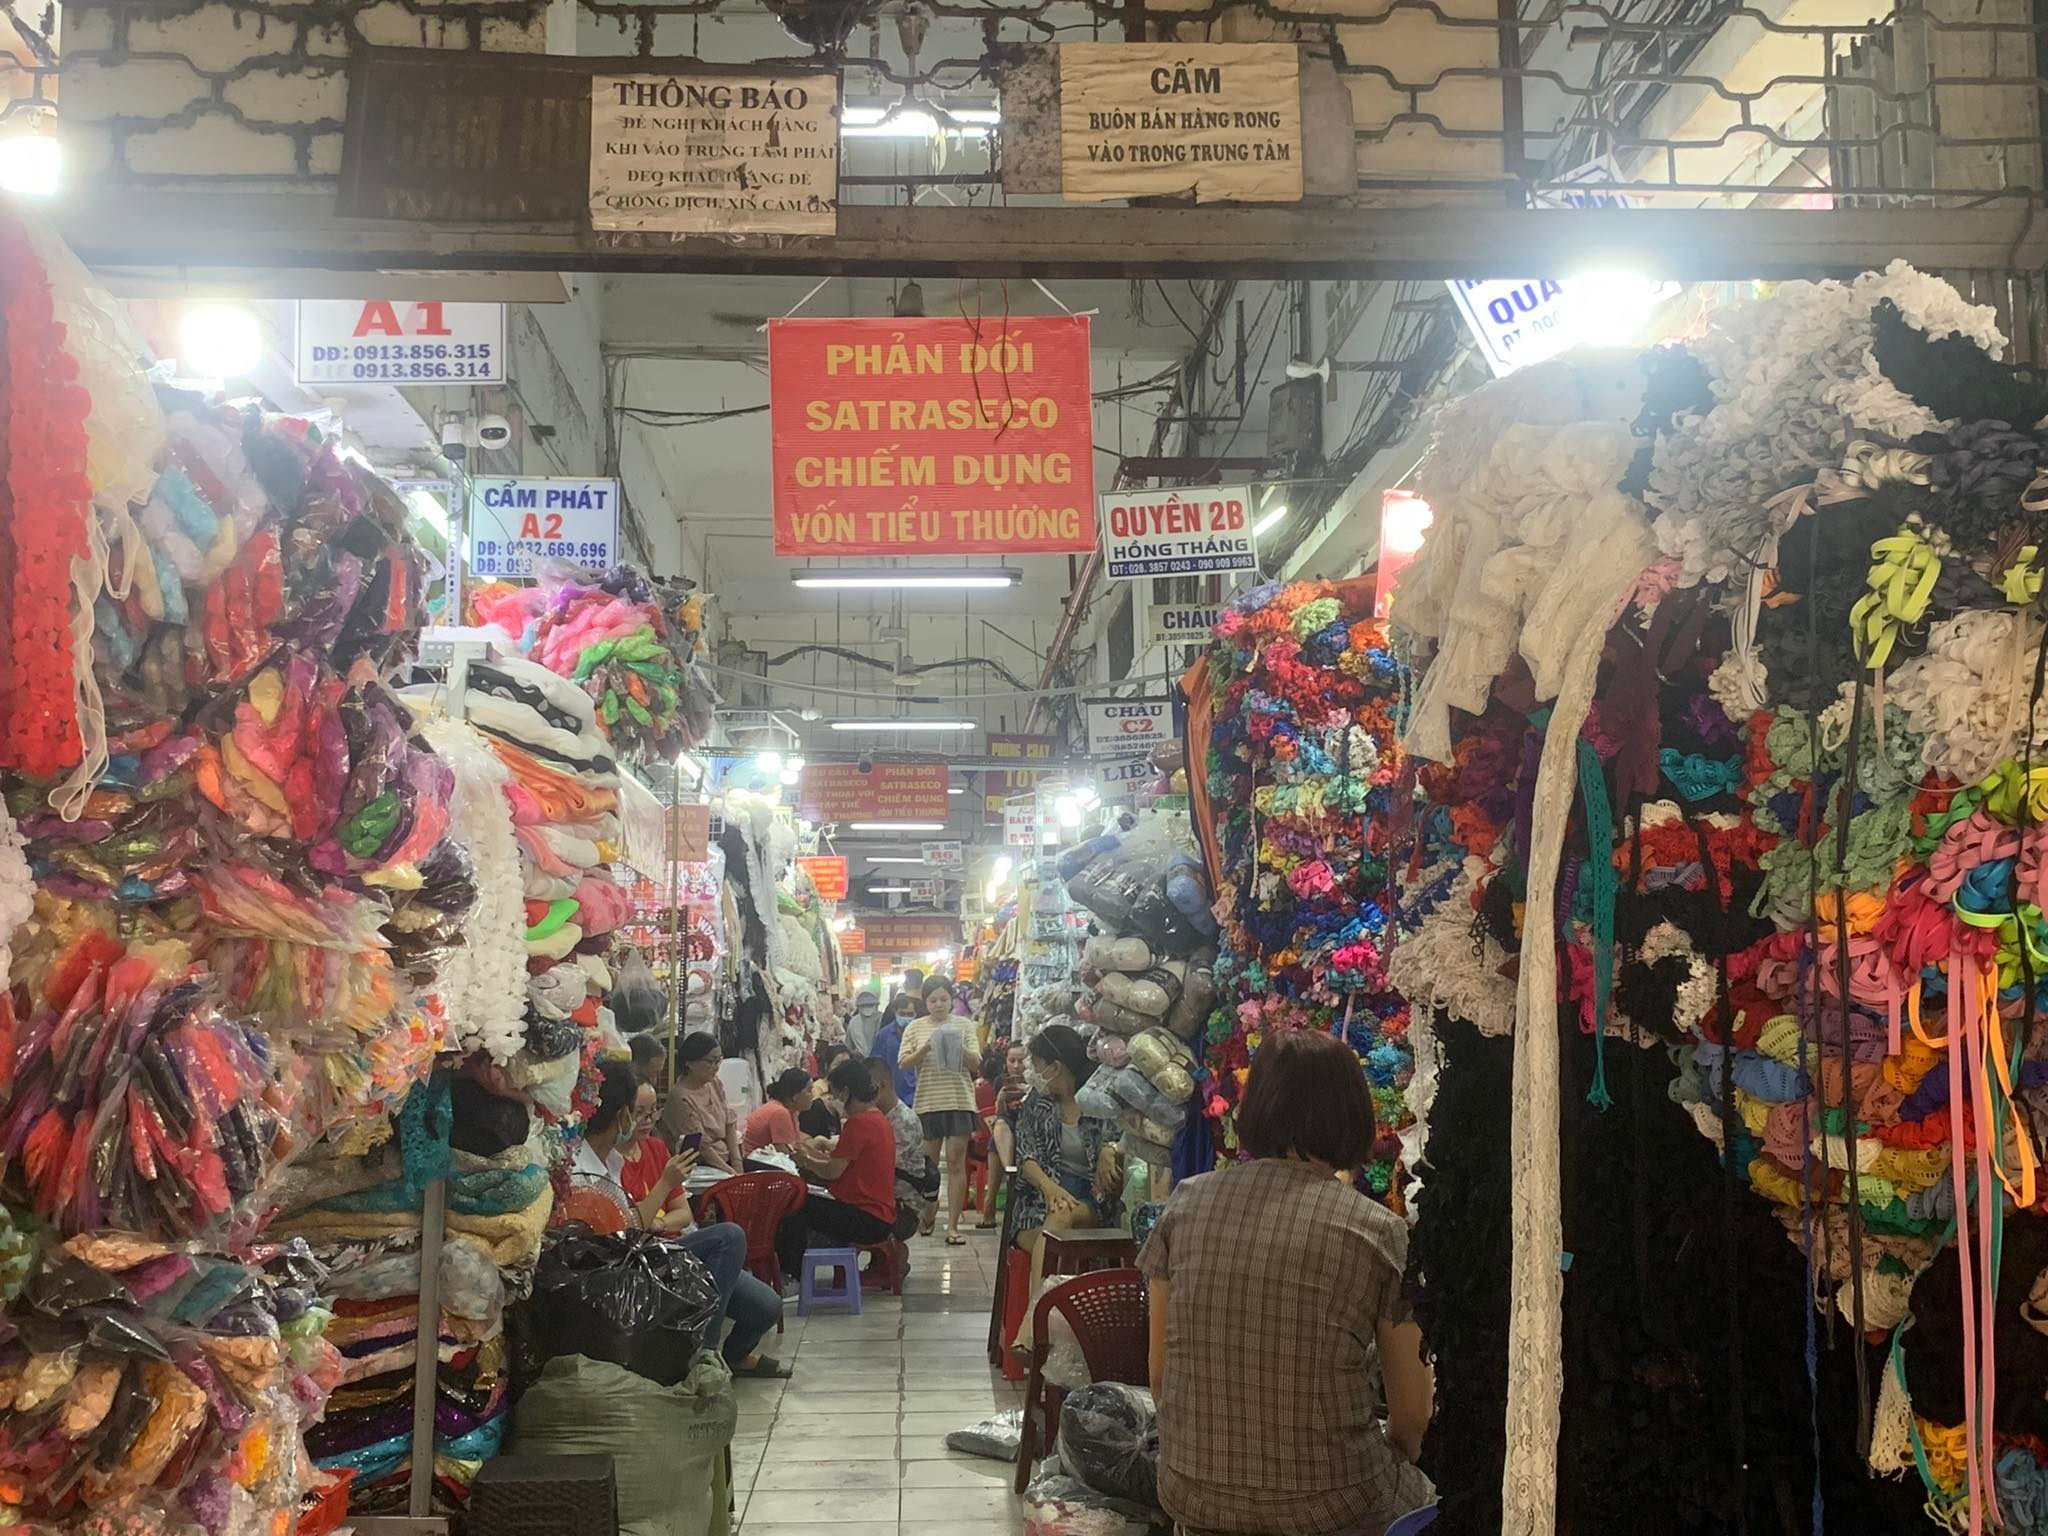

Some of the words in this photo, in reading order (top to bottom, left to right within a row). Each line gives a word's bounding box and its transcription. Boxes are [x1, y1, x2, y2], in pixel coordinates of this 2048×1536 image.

[1150, 58, 1221, 94] CẤM
[613, 78, 732, 109] THÔNG
[741, 80, 809, 110] BÁO
[652, 117, 695, 133] NGHỊ
[701, 115, 762, 133] KHÁCH
[1089, 107, 1136, 130] BUÔN
[1141, 107, 1176, 129] BÁN
[1181, 107, 1229, 129] HÀNG
[1233, 111, 1281, 129] RONG
[606, 142, 637, 155] KHI
[643, 140, 680, 156] VÀO
[685, 144, 745, 157] TRUNG
[1088, 140, 1125, 162] VÀO
[1129, 144, 1186, 162] TRONG
[1191, 144, 1249, 162] TRUNG
[1253, 138, 1291, 161] TÂM
[352, 299, 452, 337] A1
[353, 344, 491, 361] 0913.856.315
[826, 332, 944, 375] PHẢN
[959, 330, 1034, 374] ĐỐI
[353, 362, 491, 378] 0913.856.314
[806, 398, 1058, 431] SATRASECO
[795, 444, 936, 487] CHIẾM
[953, 453, 1072, 491] DỤNG
[484, 480, 537, 508] CẨM
[545, 484, 608, 510] PHÁT
[520, 513, 564, 539] A2
[790, 500, 856, 543] VỐN
[867, 496, 940, 542] TIỂU
[952, 503, 1080, 540] THƯƠNG
[1110, 493, 1202, 538] QUYỀN
[1208, 500, 1245, 532] 2B
[477, 541, 501, 556] DĐ:
[1114, 540, 1172, 560] HỒNG
[1177, 534, 1249, 555] THẮNG
[477, 558, 501, 573] DĐ:
[1163, 605, 1218, 629] CHÂU
[1104, 702, 1163, 718] CHÂU
[1120, 719, 1153, 734] C2
